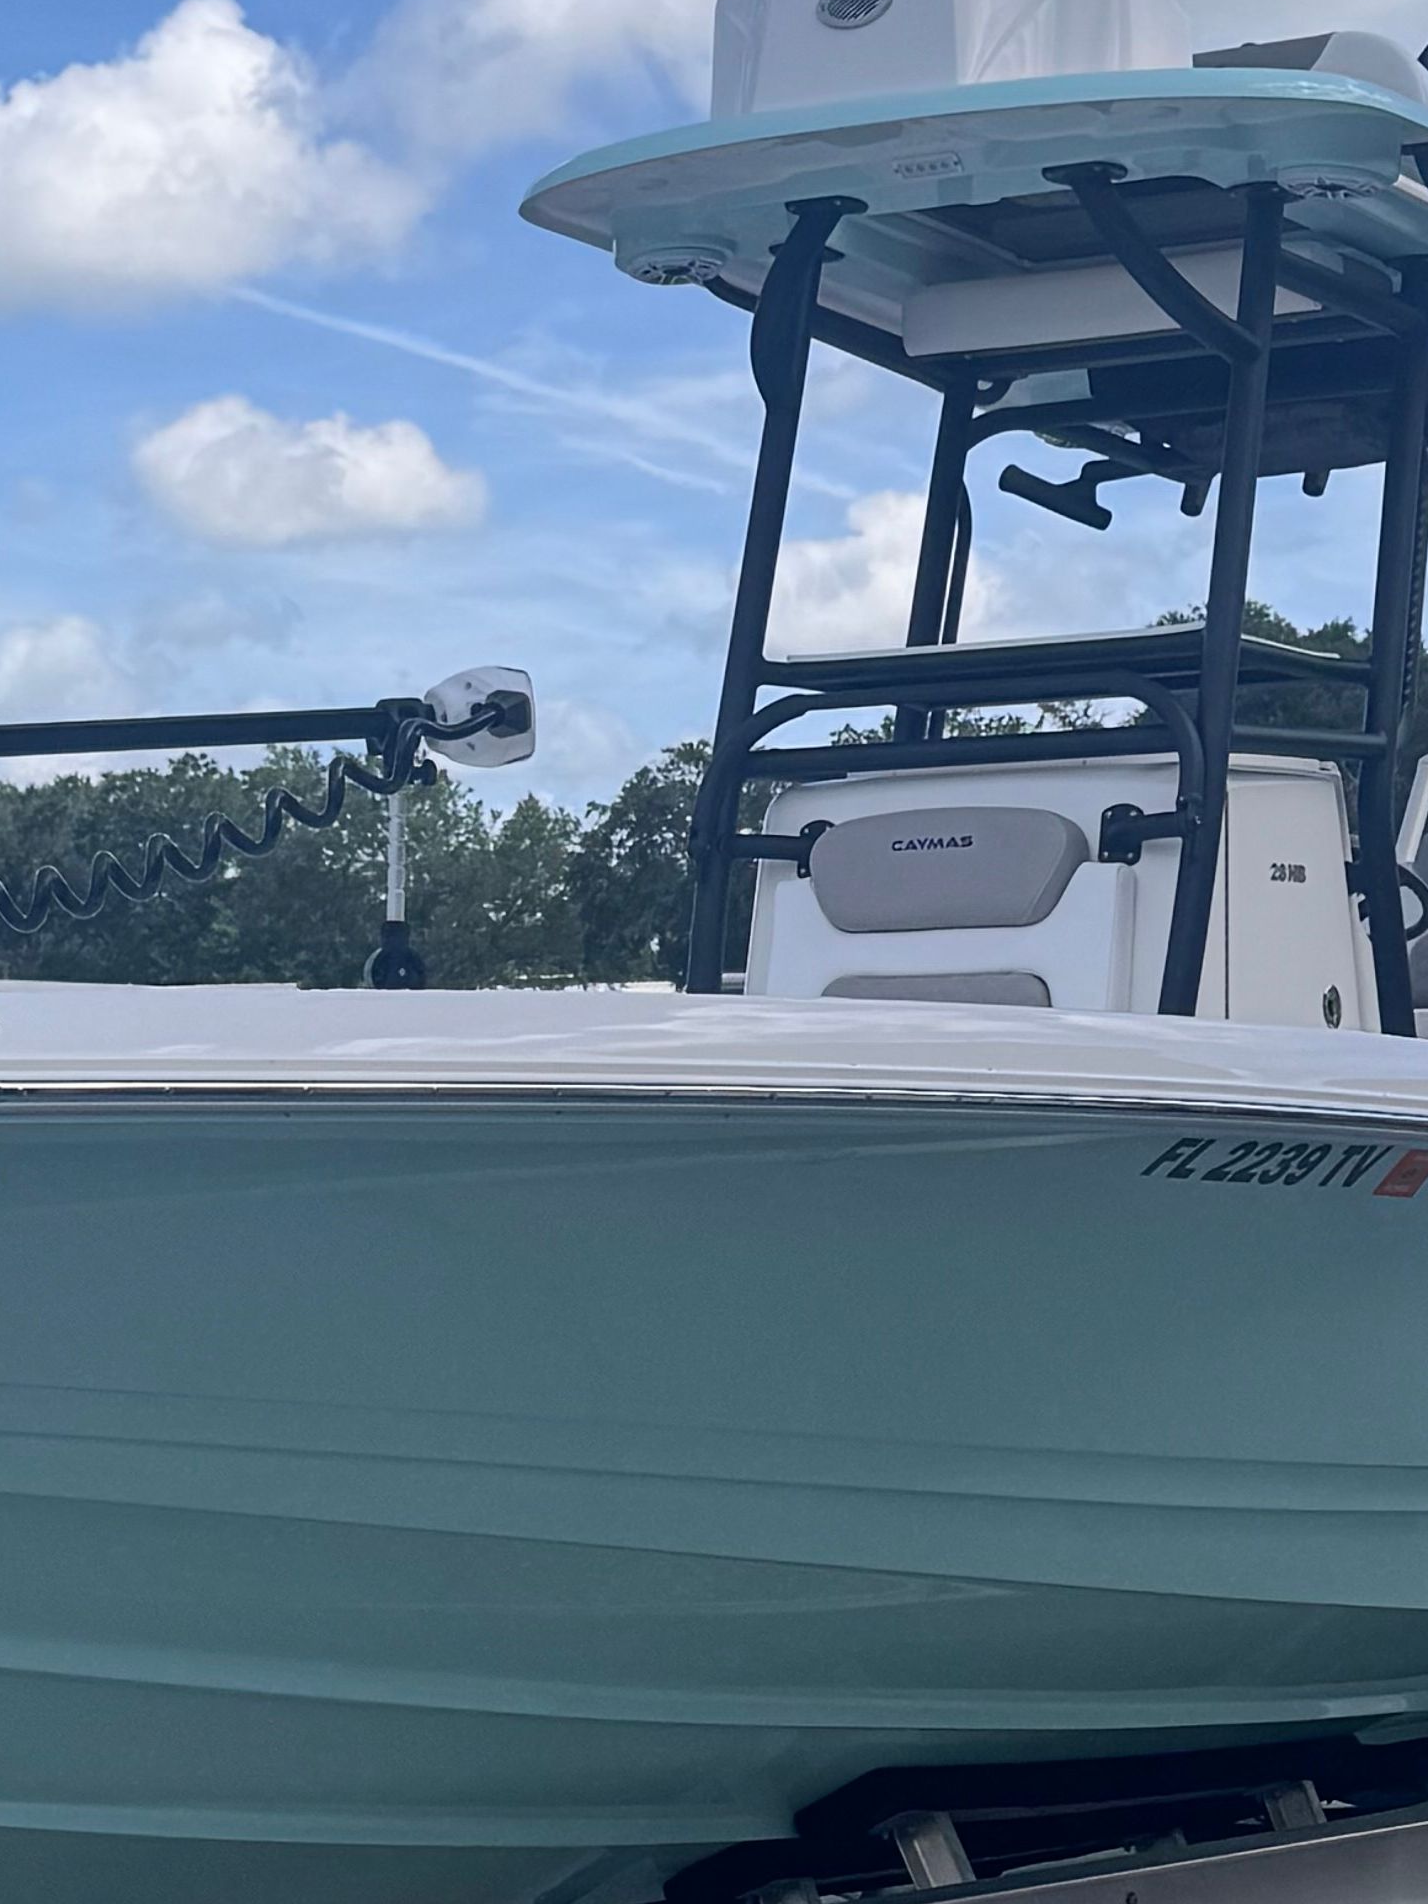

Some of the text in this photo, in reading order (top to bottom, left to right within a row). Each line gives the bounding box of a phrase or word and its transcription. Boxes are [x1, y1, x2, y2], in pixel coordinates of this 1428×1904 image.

[891, 835, 974, 852] CAYMAS
[1140, 1137, 1395, 1188] FL 2239 TV
